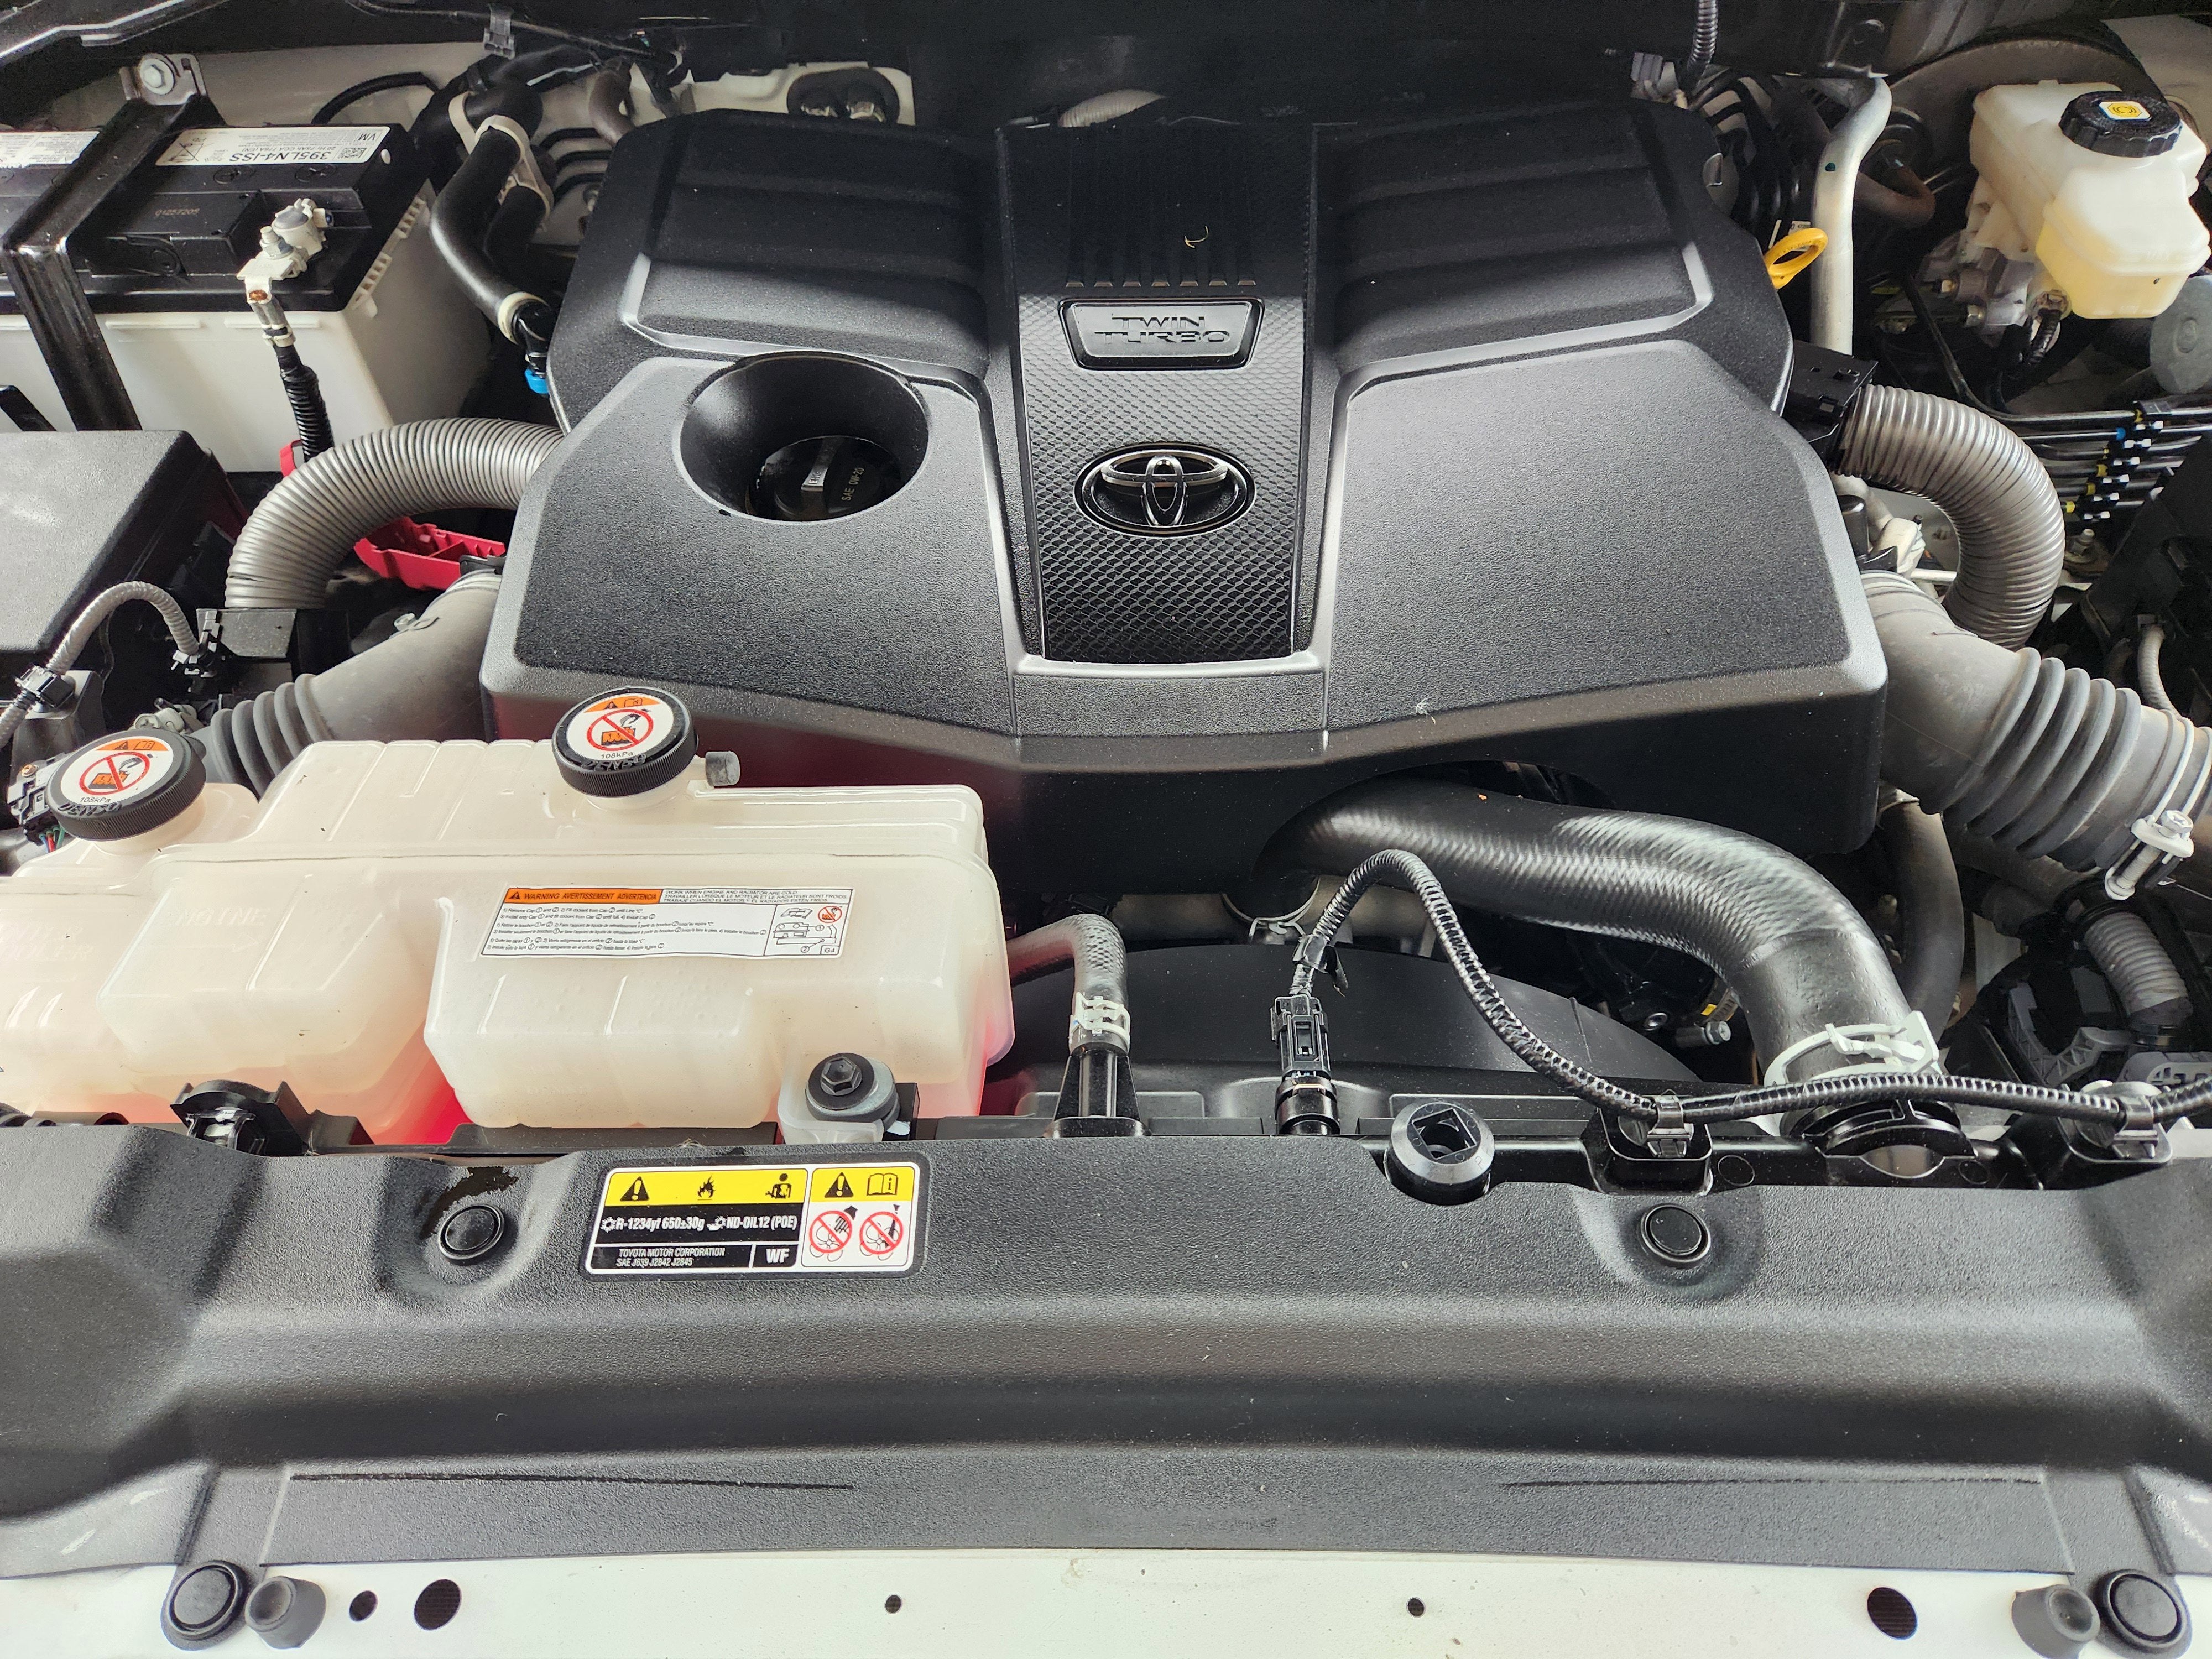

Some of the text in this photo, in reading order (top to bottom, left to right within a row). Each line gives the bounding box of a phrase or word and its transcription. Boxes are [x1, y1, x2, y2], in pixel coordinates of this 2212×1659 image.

[358, 132, 377, 141] VM
[229, 151, 331, 162] 395LN4-ISS
[1112, 316, 1205, 329] TWIN
[1094, 330, 1231, 345] TURBO
[841, 467, 864, 501] SAE 0W-20
[57, 802, 122, 816] DENSO
[615, 1215, 797, 1233] R-1234yf 650±30g ND-OIL12 (POE)
[619, 1247, 726, 1258] TOYOTA MOTOR CORPORATION
[766, 1248, 790, 1264] WF
[615, 1258, 693, 1267] SAE J639 J2842 J2845
